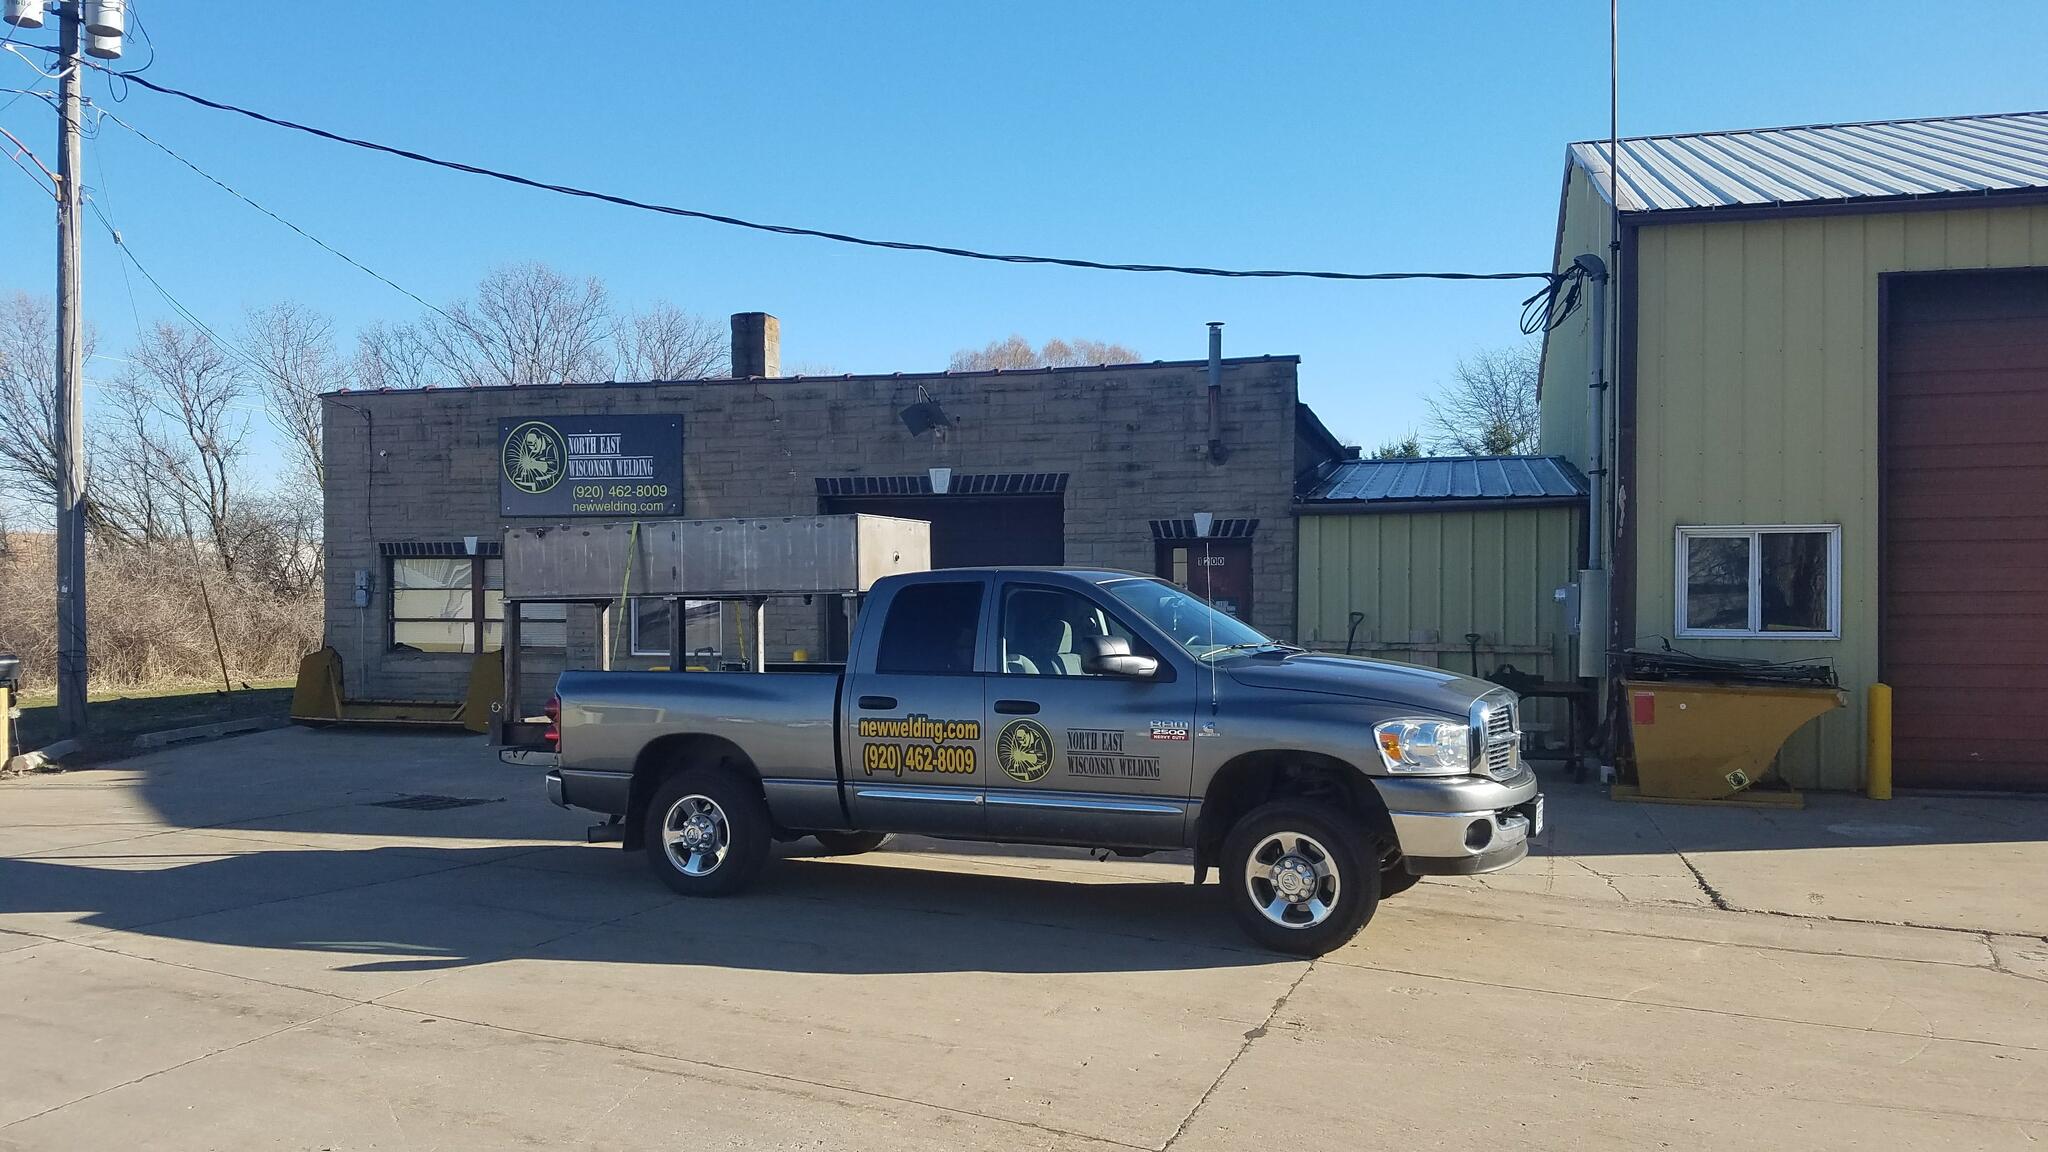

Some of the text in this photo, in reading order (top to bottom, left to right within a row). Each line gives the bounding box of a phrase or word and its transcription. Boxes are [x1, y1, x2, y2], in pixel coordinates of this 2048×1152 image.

[568, 436, 622, 454] NORTH EAST
[569, 458, 654, 477] WISCONSIN WELDING
[572, 485, 668, 500] (920) 462-8009
[572, 501, 664, 513] newwelding.com
[860, 716, 979, 743] newwelding.com
[1067, 731, 1125, 752] NORTH EAST
[864, 744, 975, 776] (920) 462-8009
[1067, 756, 1160, 778] WISCONSIN WELDING
